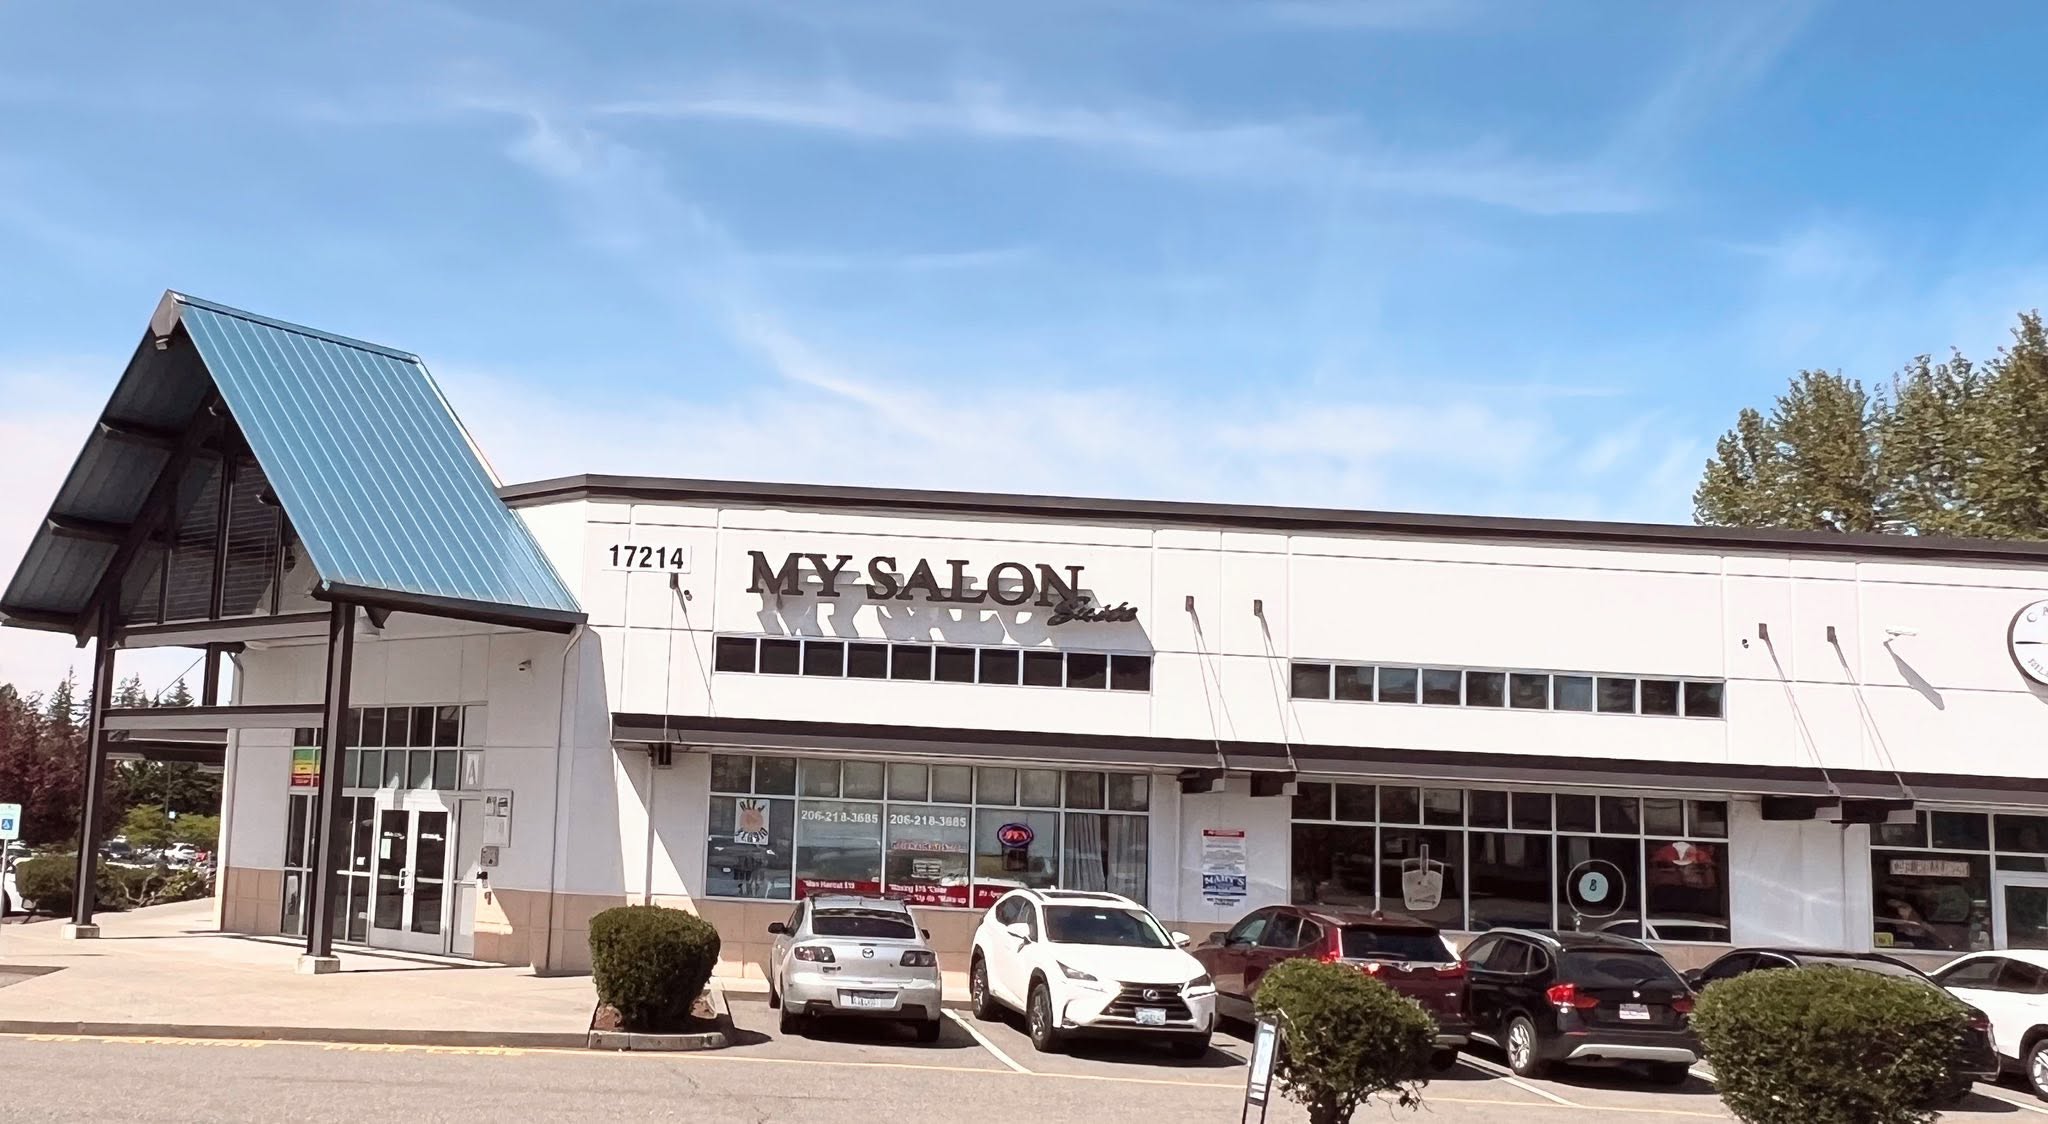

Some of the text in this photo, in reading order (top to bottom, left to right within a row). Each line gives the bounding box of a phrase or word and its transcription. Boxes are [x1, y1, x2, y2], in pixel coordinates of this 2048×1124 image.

[609, 544, 684, 570] 17214
[746, 550, 1085, 607] MY SALON
